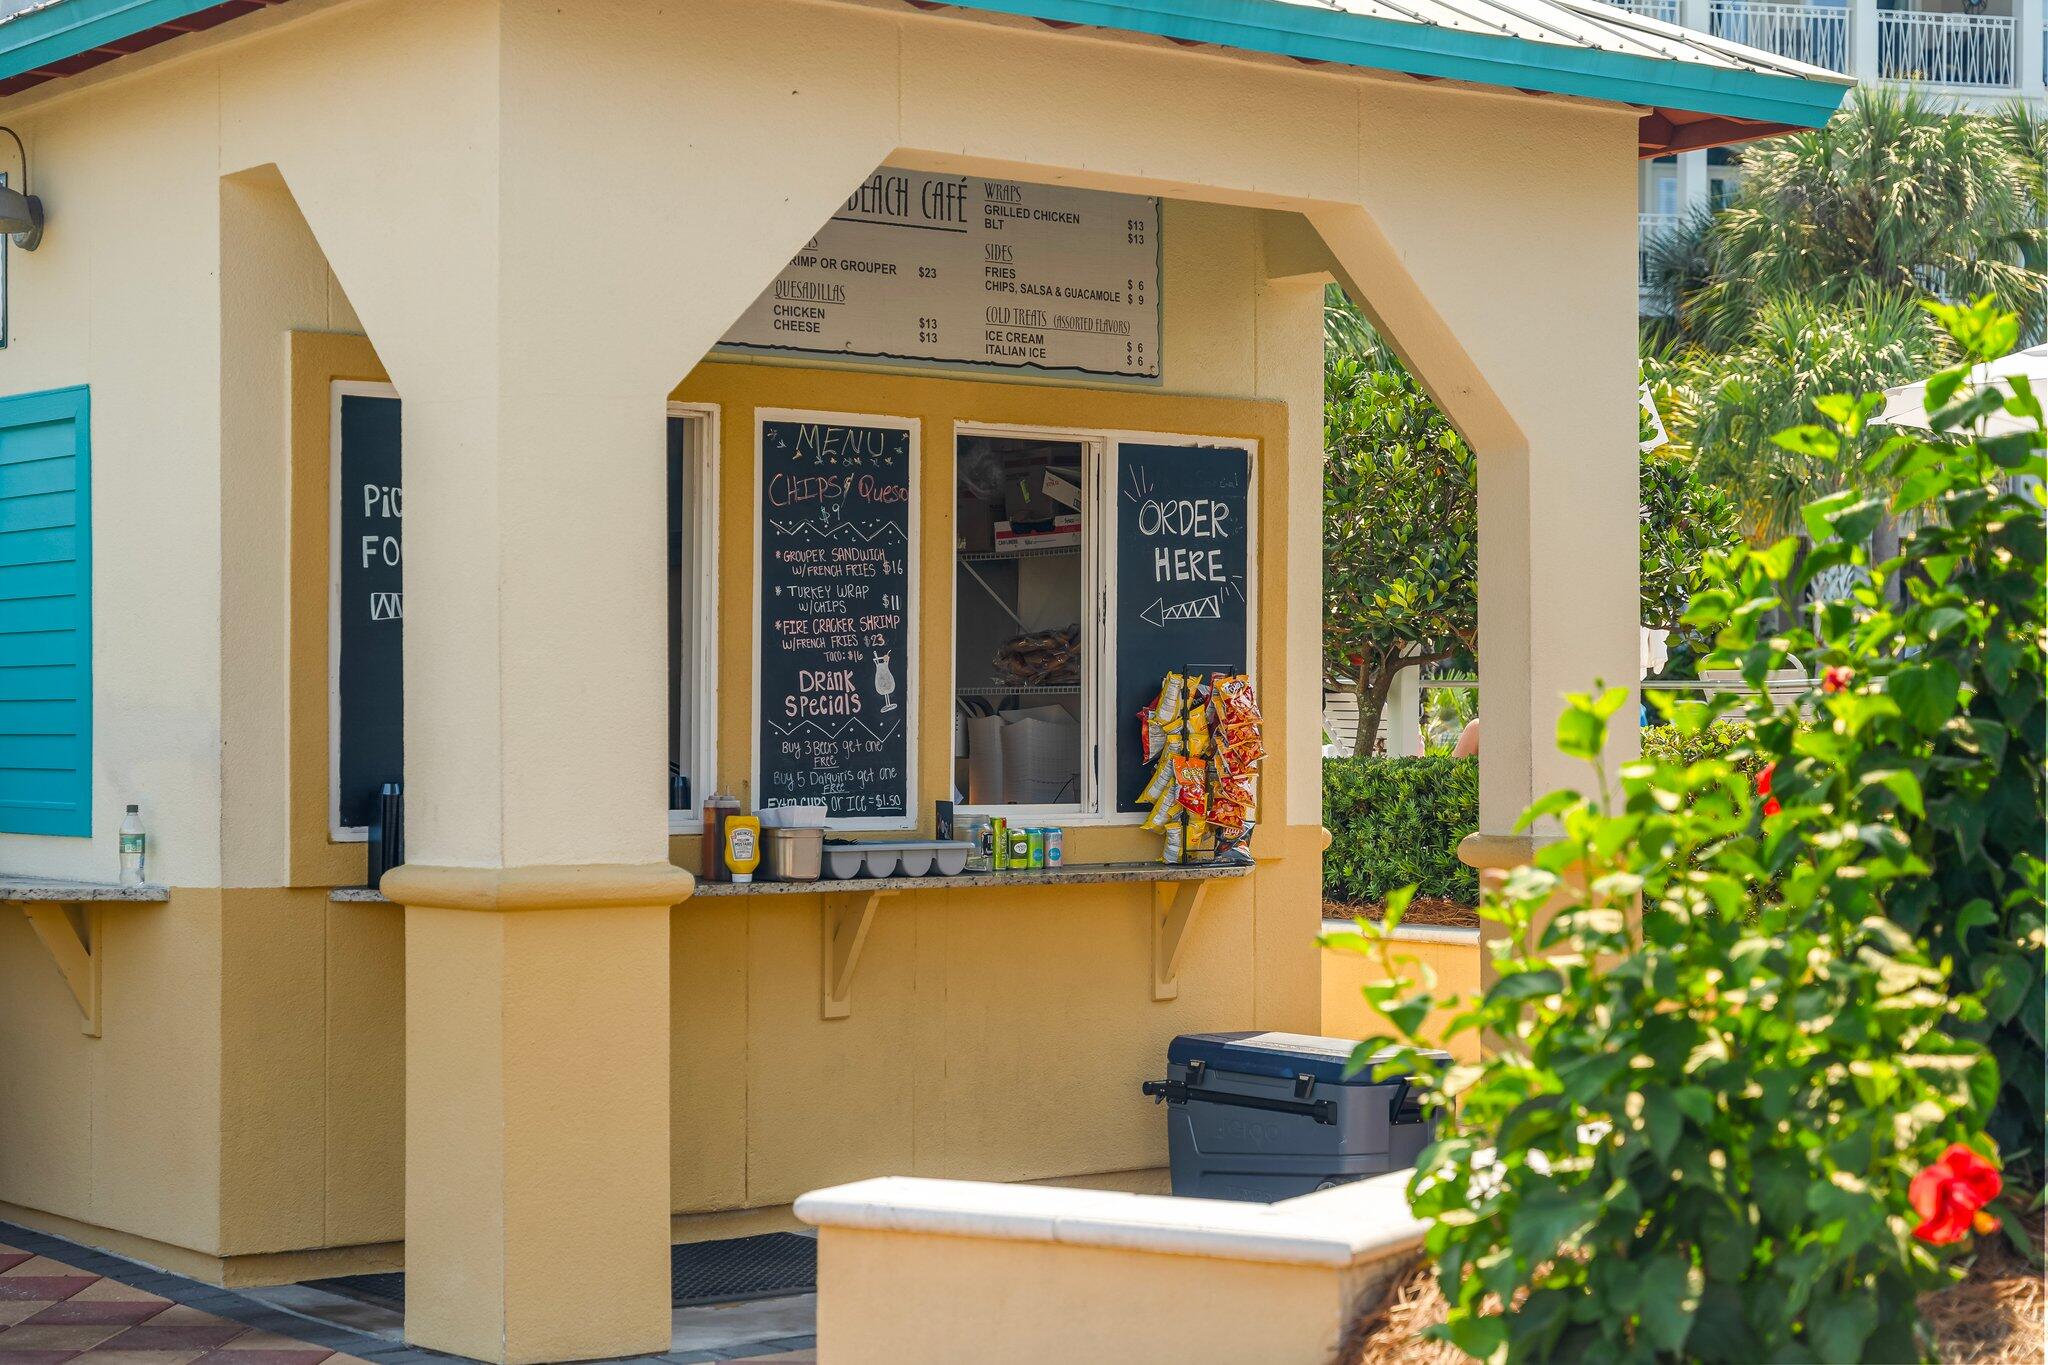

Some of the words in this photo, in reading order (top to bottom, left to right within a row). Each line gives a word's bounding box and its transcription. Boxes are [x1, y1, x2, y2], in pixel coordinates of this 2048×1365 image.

[922, 177, 968, 223] CAFÉ
[984, 182, 1022, 203] WRAPS
[984, 204, 1031, 219] GRILLED
[1033, 209, 1080, 224] CHICKEN
[984, 217, 1005, 230] BLT
[1127, 219, 1144, 231] $13
[1127, 233, 1145, 245] $13
[984, 243, 1013, 262] SIDES
[820, 257, 837, 270] OR
[840, 259, 897, 275] GROUPER
[918, 266, 937, 279] $23
[985, 266, 1016, 279] FRIES
[775, 279, 846, 302] QUESADILLAS
[985, 280, 1018, 295] CHIPS,
[1020, 283, 1052, 297] SALSA
[1054, 286, 1062, 297] &
[1064, 287, 1121, 303] GUACAMOLE
[773, 304, 825, 319] CHICKEN
[986, 305, 1011, 324] COLD
[1013, 308, 1047, 327] TREATS
[1053, 314, 1094, 331] (ASSORTED
[1095, 318, 1131, 335] FLAVORS)
[773, 318, 821, 333] CHEESE
[918, 317, 938, 330] $13
[919, 331, 938, 344] $13
[985, 330, 1003, 342] ICE
[1005, 331, 1044, 345] CREAM
[985, 344, 1026, 357] ITALIAN
[1029, 346, 1046, 359] ICE
[796, 424, 884, 457] MENU
[769, 473, 841, 507] CHIPS
[819, 503, 841, 525] $9
[1138, 499, 1229, 538] ORDER
[783, 548, 827, 563] GROUPER
[831, 547, 886, 562] SANDWICH
[845, 563, 876, 577] FRIES
[882, 560, 903, 575] $16
[1154, 546, 1226, 582] HERE
[786, 585, 831, 600] TURKEY
[836, 583, 870, 600] WRAP
[882, 593, 901, 611] $11
[782, 619, 809, 635] FIRE
[812, 617, 857, 635] CRACKER
[860, 614, 901, 632] SHRIMP
[831, 634, 859, 649] FRIES
[863, 633, 886, 648] $23
[847, 650, 864, 663] $16
[804, 740, 812, 755] 3
[842, 738, 862, 760] get
[864, 739, 883, 753] one
[796, 771, 806, 788] 5
[856, 767, 875, 790] get
[879, 766, 898, 781] one
[875, 794, 901, 808] $1.50
